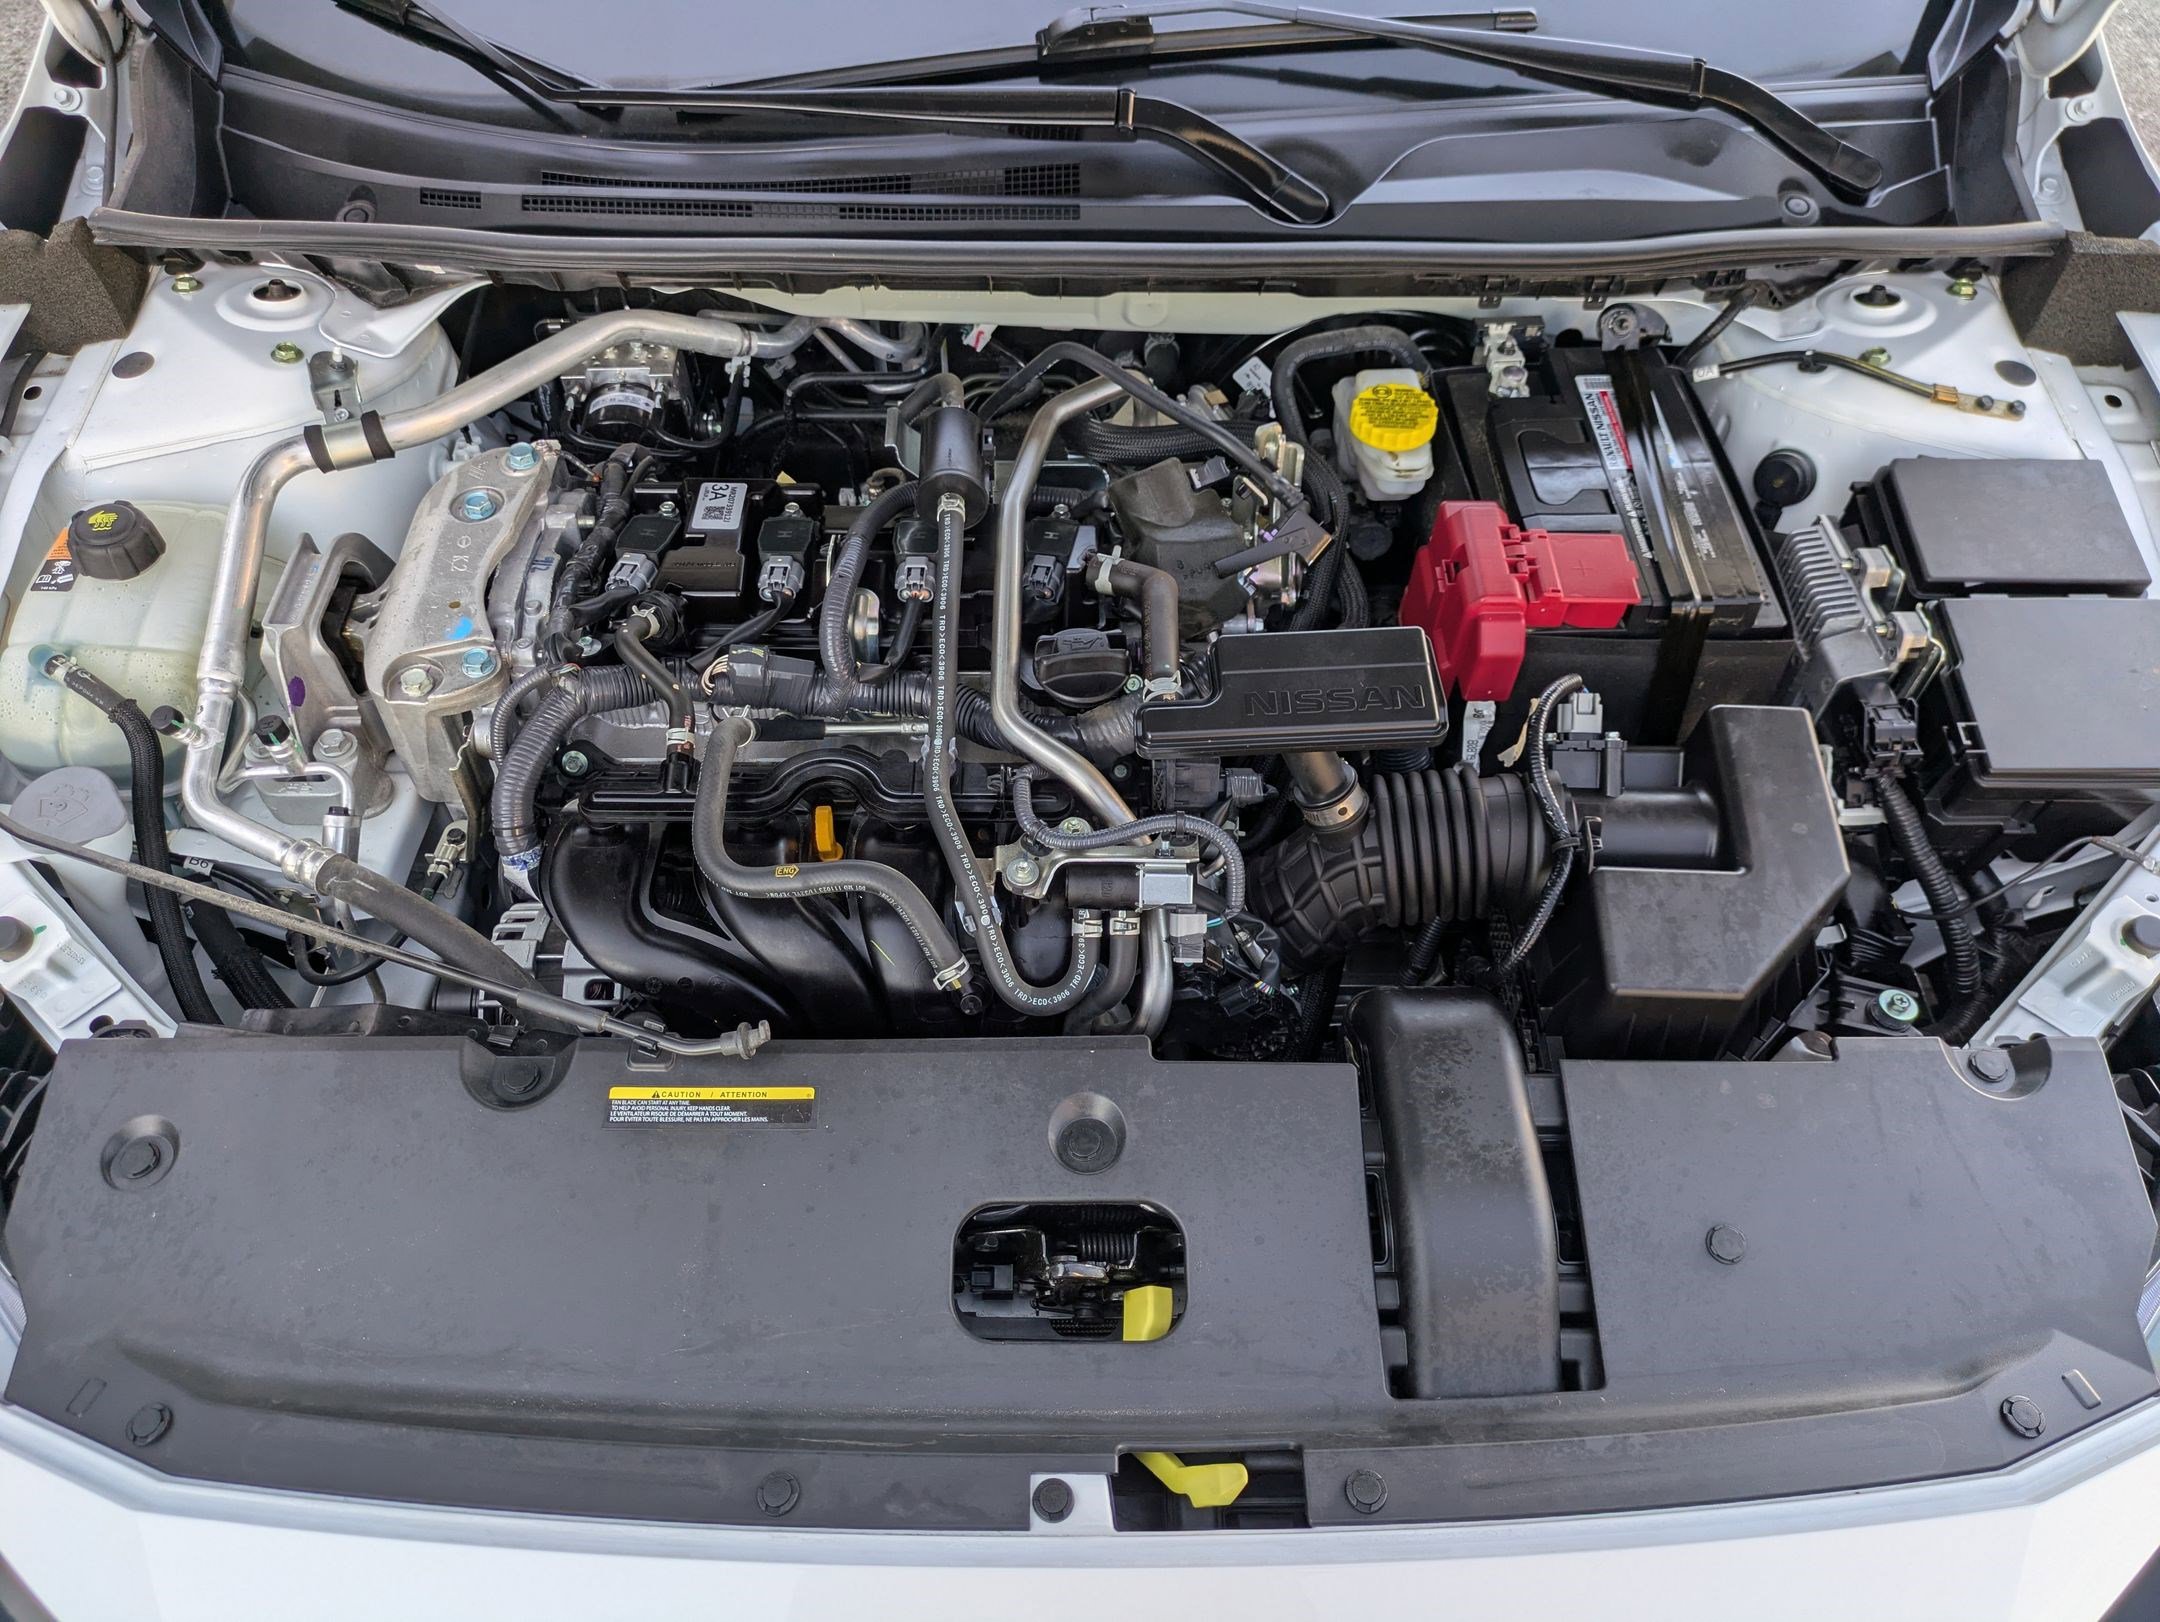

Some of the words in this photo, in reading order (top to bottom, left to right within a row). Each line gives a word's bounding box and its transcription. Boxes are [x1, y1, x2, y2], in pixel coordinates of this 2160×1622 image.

[1584, 393, 1605, 431] NISSAN
[709, 484, 729, 501] 3A
[940, 560, 950, 610] TRD>ECO<3906
[938, 614, 946, 681] TRD>ECO<3906
[1247, 684, 1426, 716] NISSAN
[935, 795, 963, 850] TRD>ECO<3906
[778, 867, 795, 875] ENG
[986, 925, 1014, 988] TRD>ECO<3906
[1014, 988, 1071, 1006] TRD>ECO<3906
